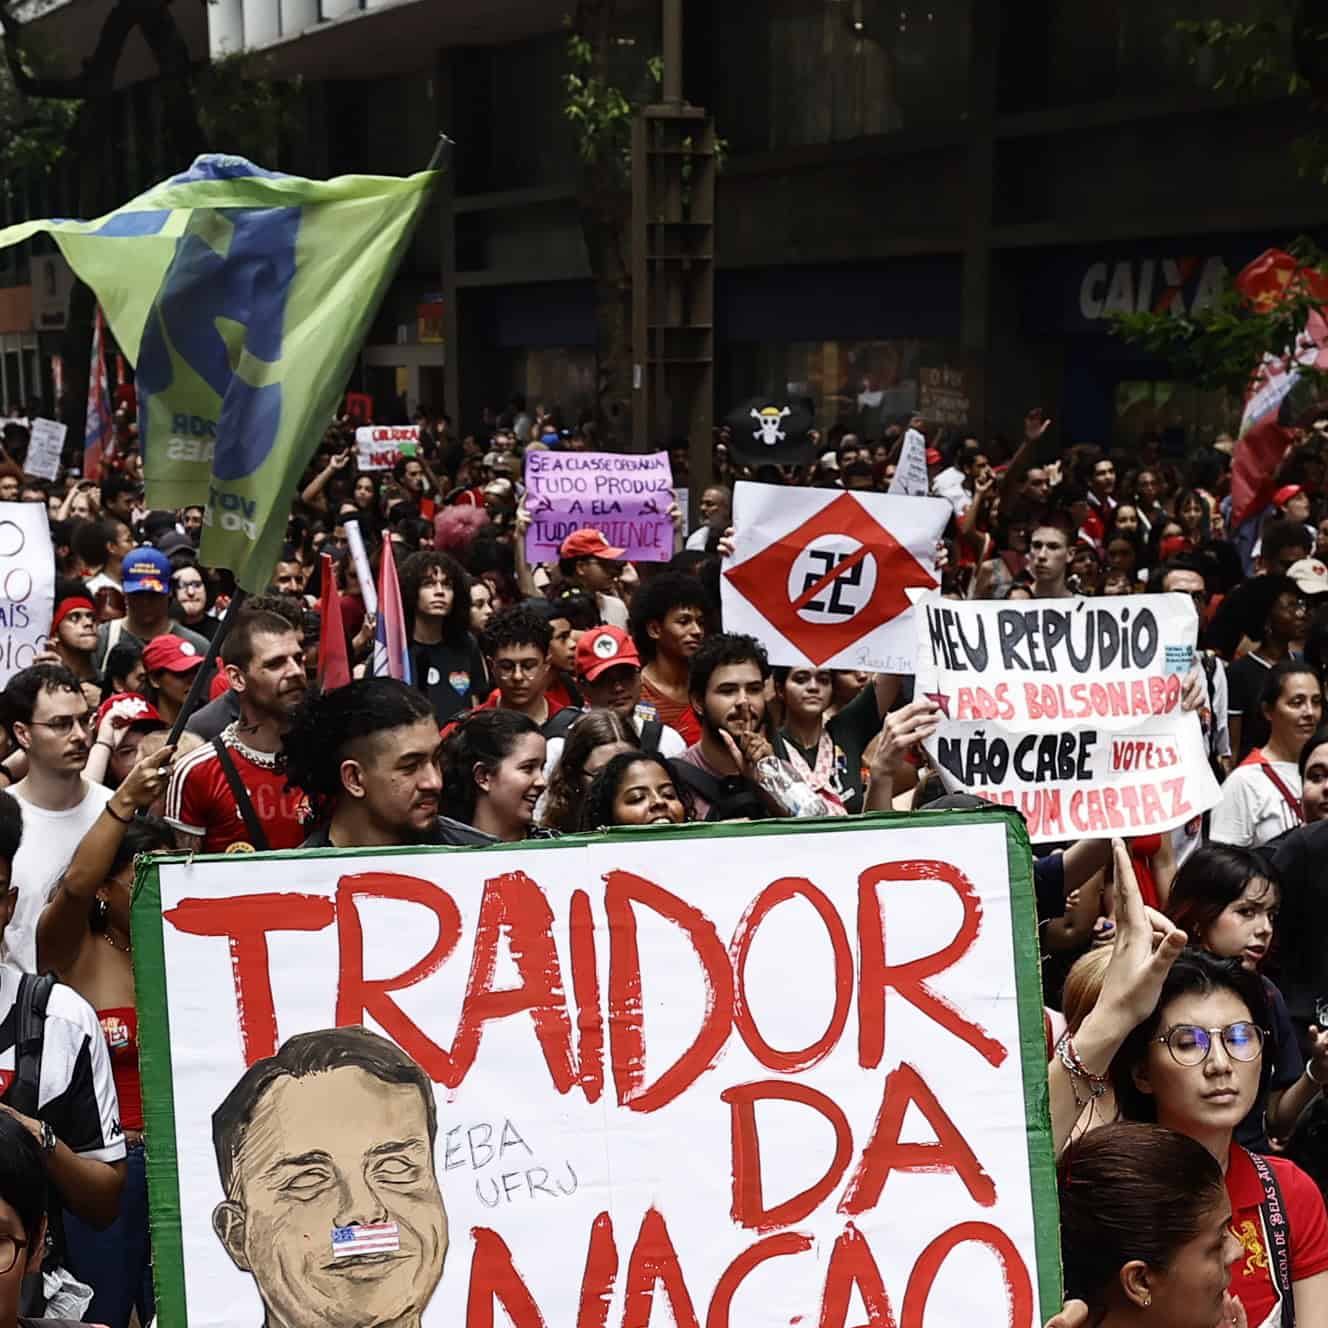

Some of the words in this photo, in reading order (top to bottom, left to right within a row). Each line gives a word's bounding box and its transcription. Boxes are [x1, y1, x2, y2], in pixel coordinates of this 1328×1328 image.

[1080, 256, 1228, 320] CAIXA
[529, 454, 550, 473] SE
[552, 459, 563, 472] A
[566, 458, 613, 472] CLASSE
[530, 476, 587, 494] TUDO
[595, 475, 668, 494] PRODUZ
[568, 500, 583, 514] A
[591, 500, 622, 515] ELA
[799, 550, 864, 615] 22
[926, 604, 989, 673] MEU
[957, 682, 1016, 720] AOS
[937, 727, 1010, 787] NÃO
[1013, 731, 1097, 782] CABE
[1112, 740, 1154, 770] VOTE
[1155, 746, 1177, 767] 13
[1069, 776, 1192, 833] CARTAZ
[162, 859, 1008, 1113] TRAIDOR
[442, 1118, 534, 1175] EBA
[721, 1062, 998, 1235] DA
[474, 1160, 579, 1209] UFRJ
[1274, 1231, 1286, 1245] DE
[1278, 1249, 1290, 1290] ESCOLA
